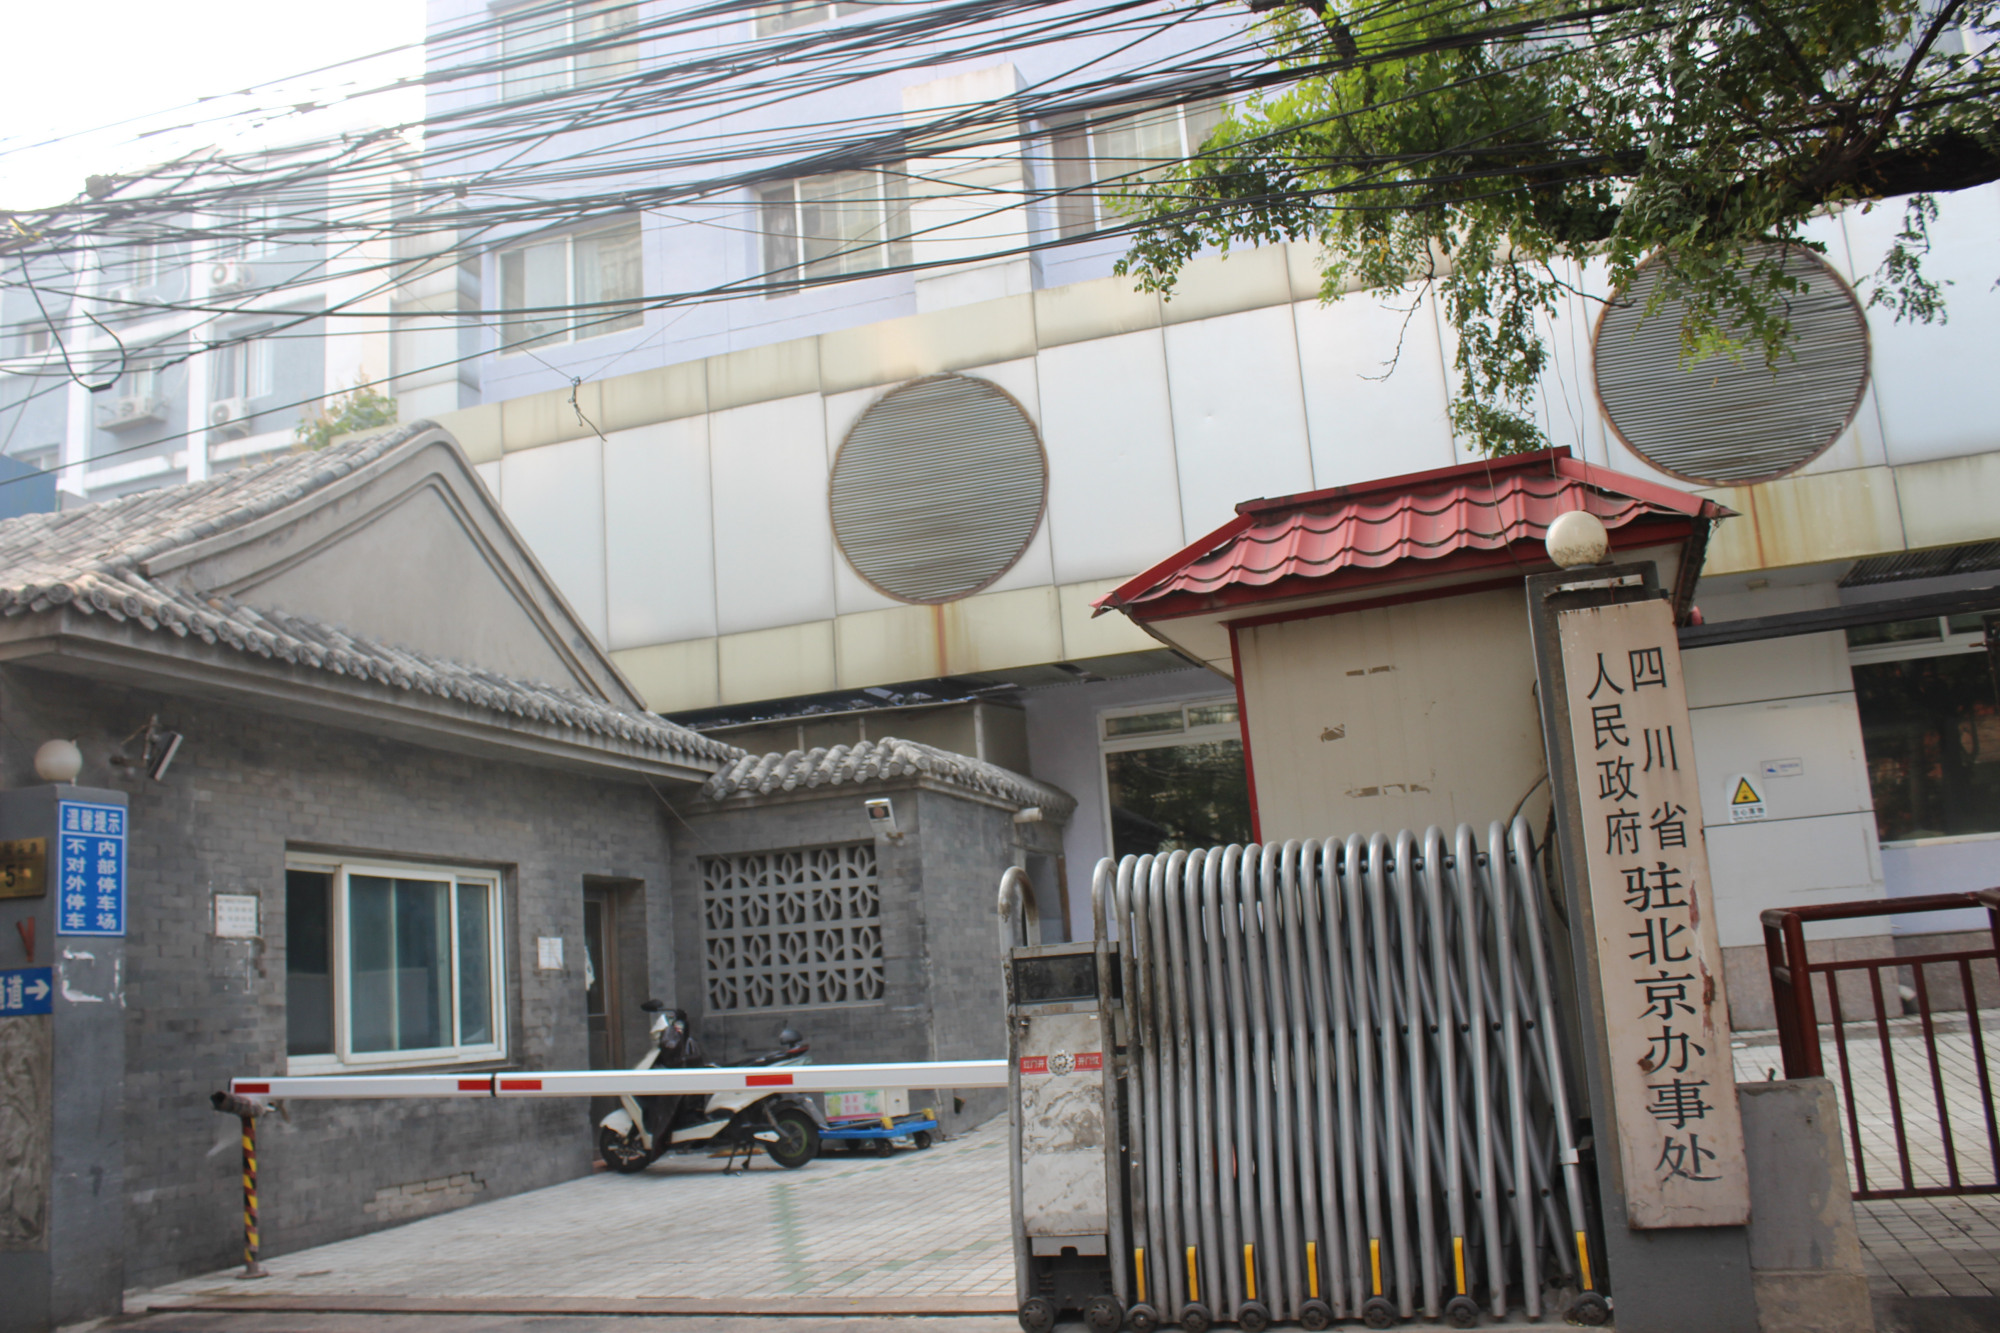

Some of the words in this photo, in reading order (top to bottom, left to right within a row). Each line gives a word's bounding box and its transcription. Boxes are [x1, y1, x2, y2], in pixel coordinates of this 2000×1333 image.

[1586, 652, 1642, 856] 人民政府
[1628, 647, 1688, 850] 四川省
[65, 838, 87, 929] 不对外停车
[96, 840, 117, 930] 内部停车场
[0, 974, 23, 1010] 道
[1620, 862, 1723, 1186] 驻北京办事处
